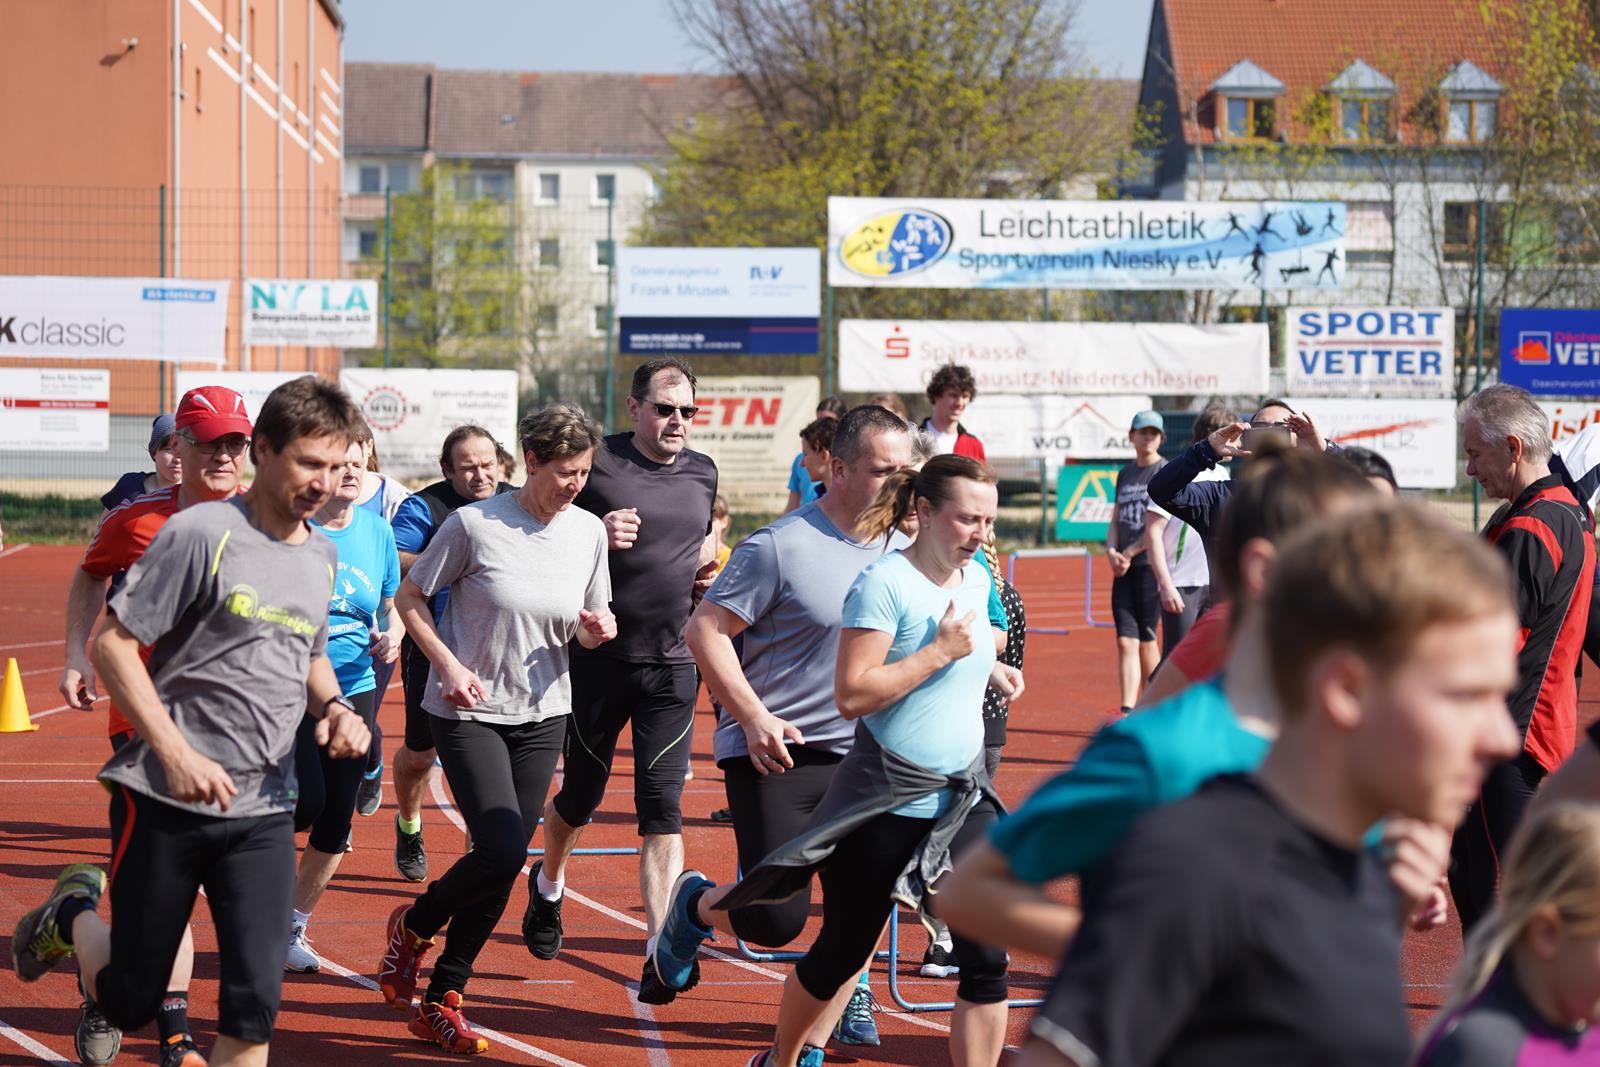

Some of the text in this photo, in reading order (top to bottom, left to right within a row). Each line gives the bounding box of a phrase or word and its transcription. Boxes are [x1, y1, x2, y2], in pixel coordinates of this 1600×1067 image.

[980, 209, 1207, 240] Leichtathletik
[959, 249, 1094, 273] Sportverein
[1103, 249, 1178, 276] Niesky
[630, 283, 671, 298] Frank
[1299, 311, 1442, 337] SPORT
[919, 341, 1027, 363] Sparkasse
[1299, 350, 1442, 375] VETTER
[350, 565, 375, 593] NIESKY
